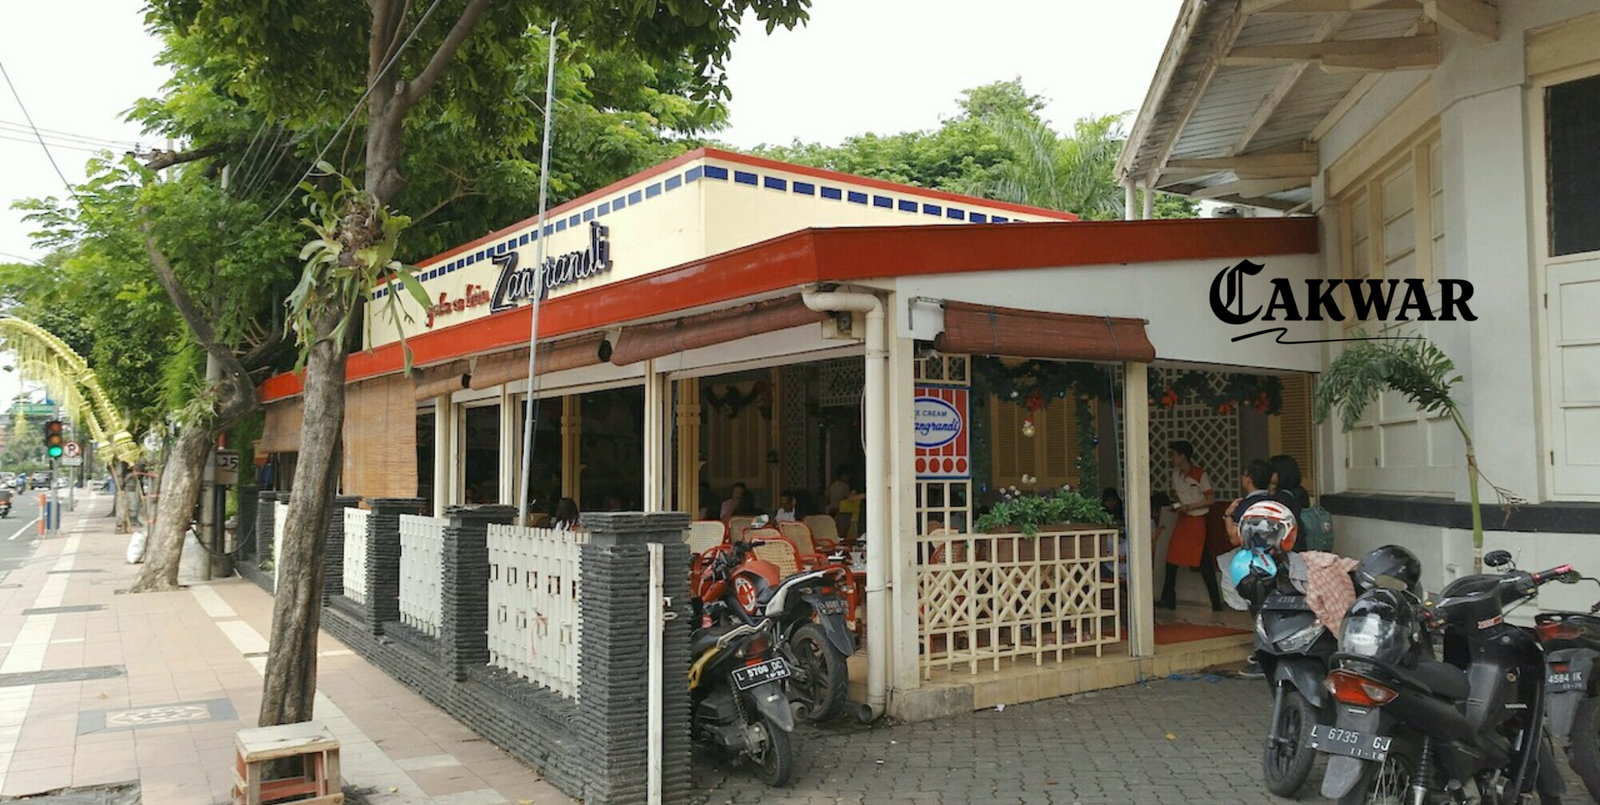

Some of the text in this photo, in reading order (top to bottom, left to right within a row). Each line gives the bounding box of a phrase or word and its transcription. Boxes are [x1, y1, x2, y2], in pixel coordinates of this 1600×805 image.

[490, 221, 613, 314] Zangrandi
[736, 672, 744, 681] L
[770, 661, 783, 671] DC
[1548, 671, 1582, 684] 4584 IK
[1311, 726, 1393, 751] L 6735 GJ
[1350, 748, 1385, 760] 11-18
